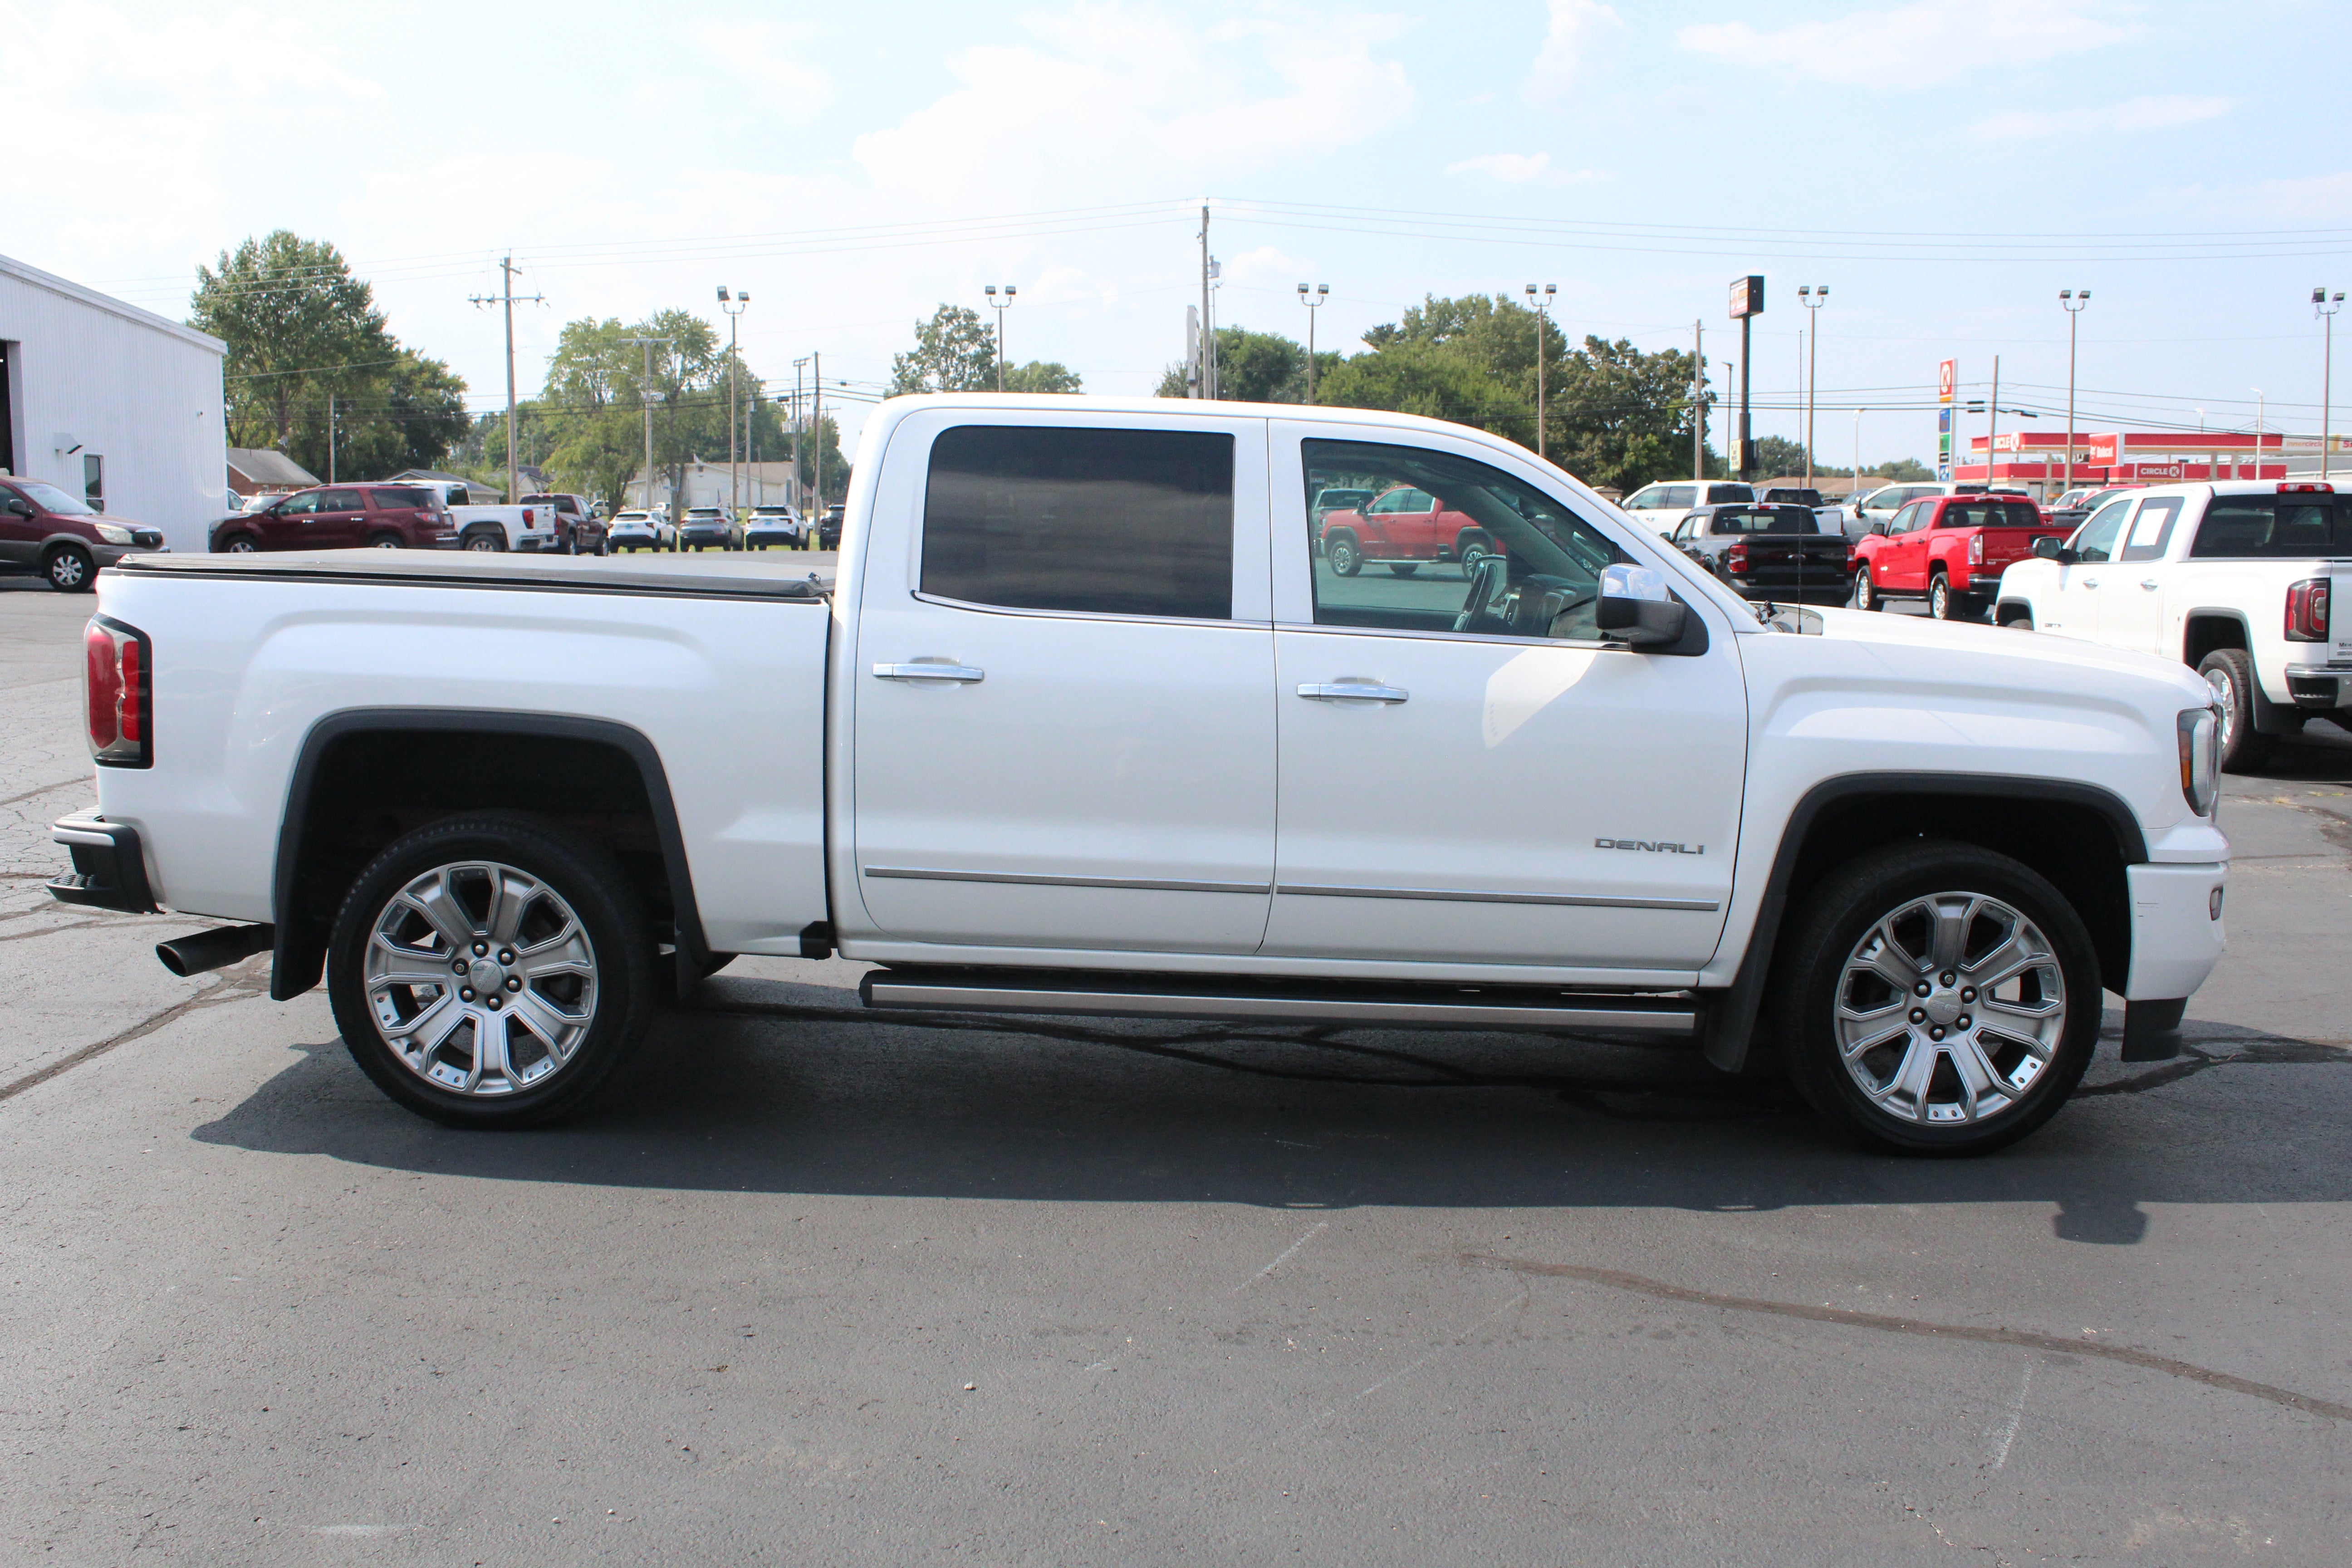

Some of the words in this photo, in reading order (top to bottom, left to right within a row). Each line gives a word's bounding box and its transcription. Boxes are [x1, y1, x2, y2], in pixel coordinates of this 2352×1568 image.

[2096, 446, 2113, 458] Bobcat
[1595, 837, 1704, 854] DENALI
[1931, 1000, 1960, 1014] GMC
